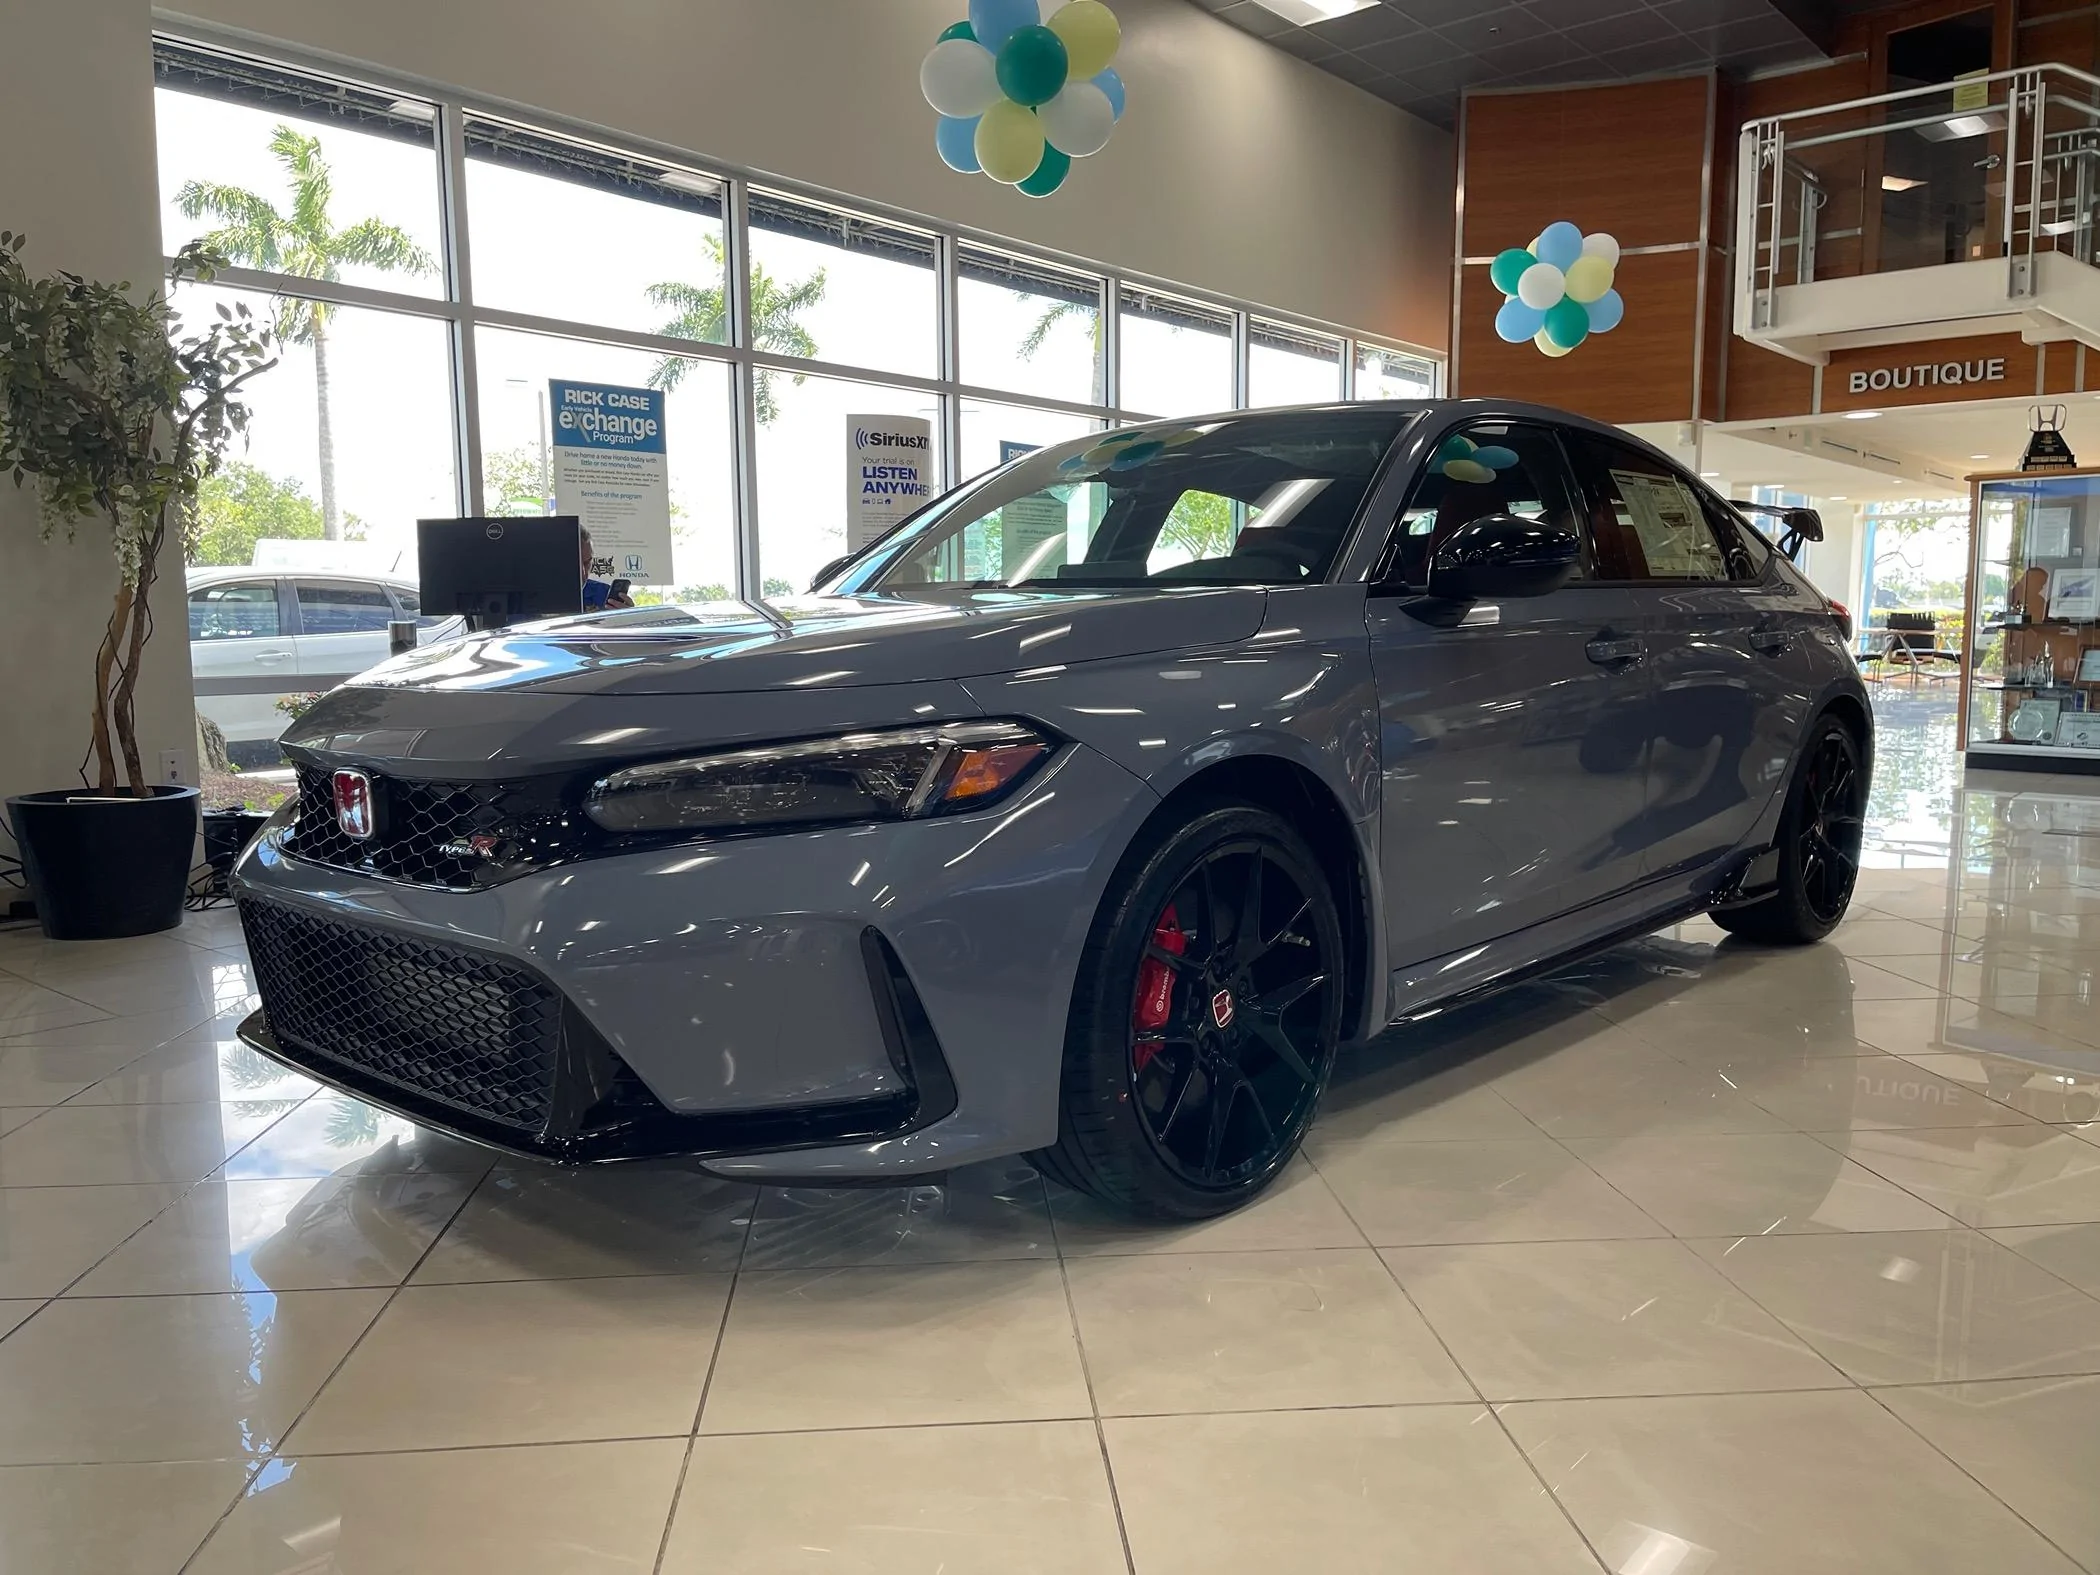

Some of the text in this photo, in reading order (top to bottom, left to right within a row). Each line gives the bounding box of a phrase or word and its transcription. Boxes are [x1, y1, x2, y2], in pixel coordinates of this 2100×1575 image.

[1849, 358, 2005, 393] BOUTIQUE
[565, 389, 650, 411] RICK CASE
[559, 407, 658, 443] exchange
[593, 431, 634, 445] Program
[630, 455, 645, 463] today
[882, 457, 898, 465] trial
[899, 457, 905, 465] is
[862, 466, 918, 480] LISTEN
[581, 490, 603, 498] Benefits
